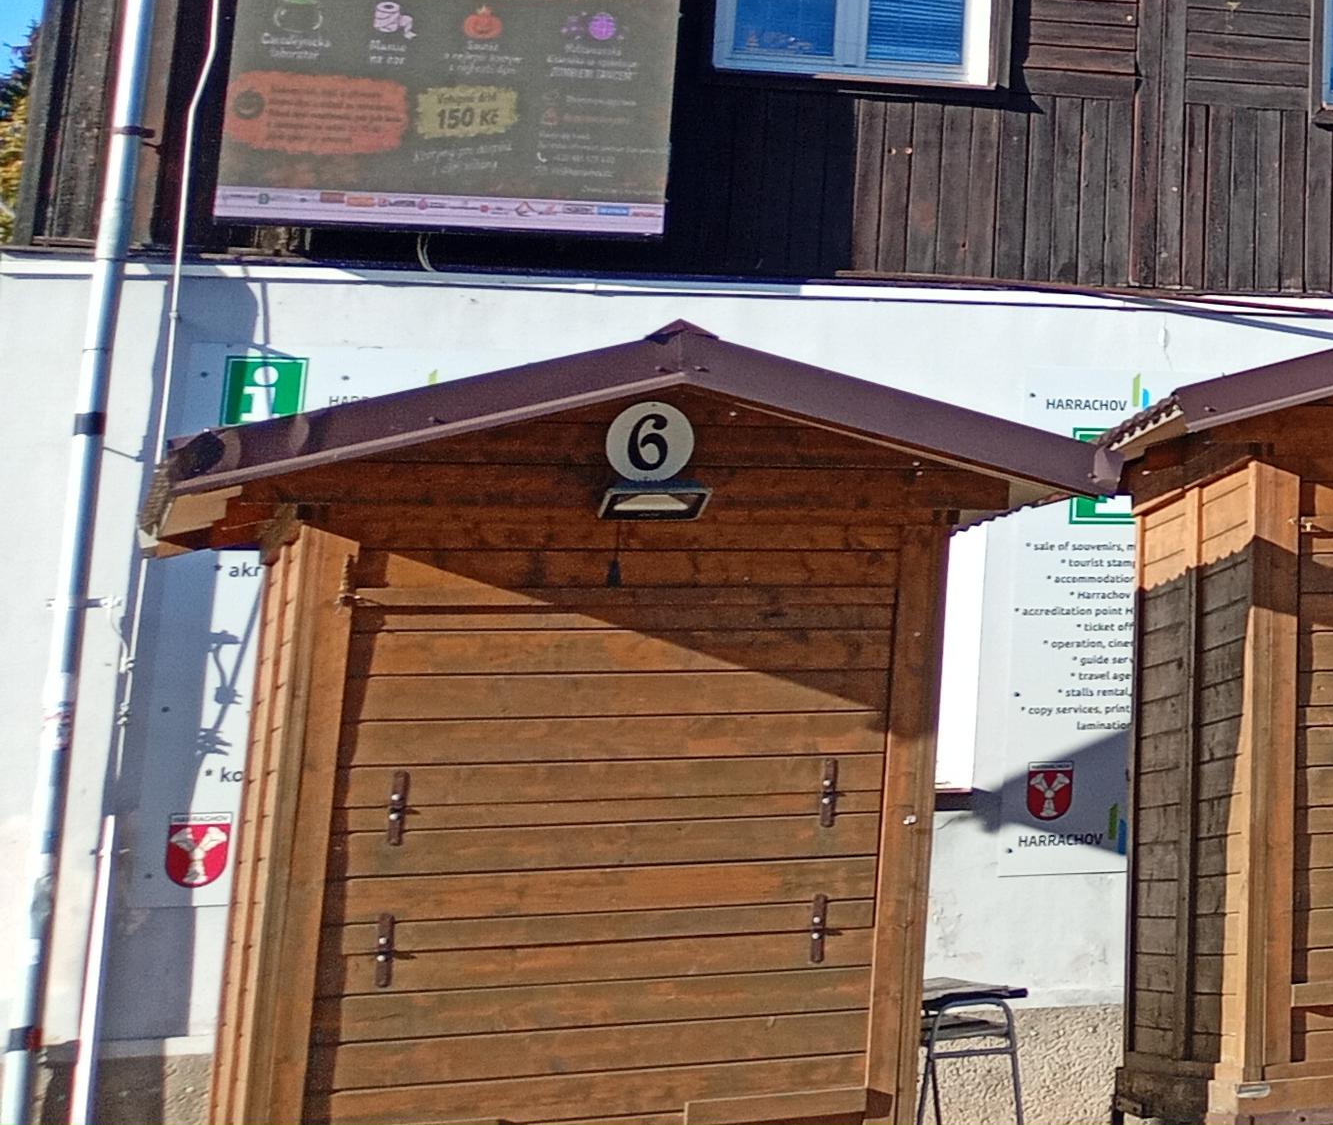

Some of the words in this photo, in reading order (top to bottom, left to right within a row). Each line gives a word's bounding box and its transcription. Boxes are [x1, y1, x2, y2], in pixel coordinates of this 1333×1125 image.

[437, 106, 475, 130] 150
[480, 108, 499, 126] Kč
[1046, 398, 1127, 412] HARRACHOV
[628, 413, 668, 471] 6
[1034, 542, 1055, 551] sale
[1058, 541, 1069, 551] of
[1071, 542, 1124, 552] souvenirs,
[1068, 558, 1105, 567] tourist
[1077, 591, 1131, 599] Harrachov
[1022, 606, 1092, 616] accreditation
[1094, 606, 1123, 617] point
[1084, 622, 1115, 631] ticket
[1051, 639, 1106, 649] operation,
[1080, 655, 1108, 666] guide
[1078, 671, 1110, 680] travel
[1065, 687, 1094, 697] stalls
[1028, 706, 1053, 716] copy
[1055, 704, 1102, 714] services,
[1018, 832, 1104, 847] HARRACHOV
